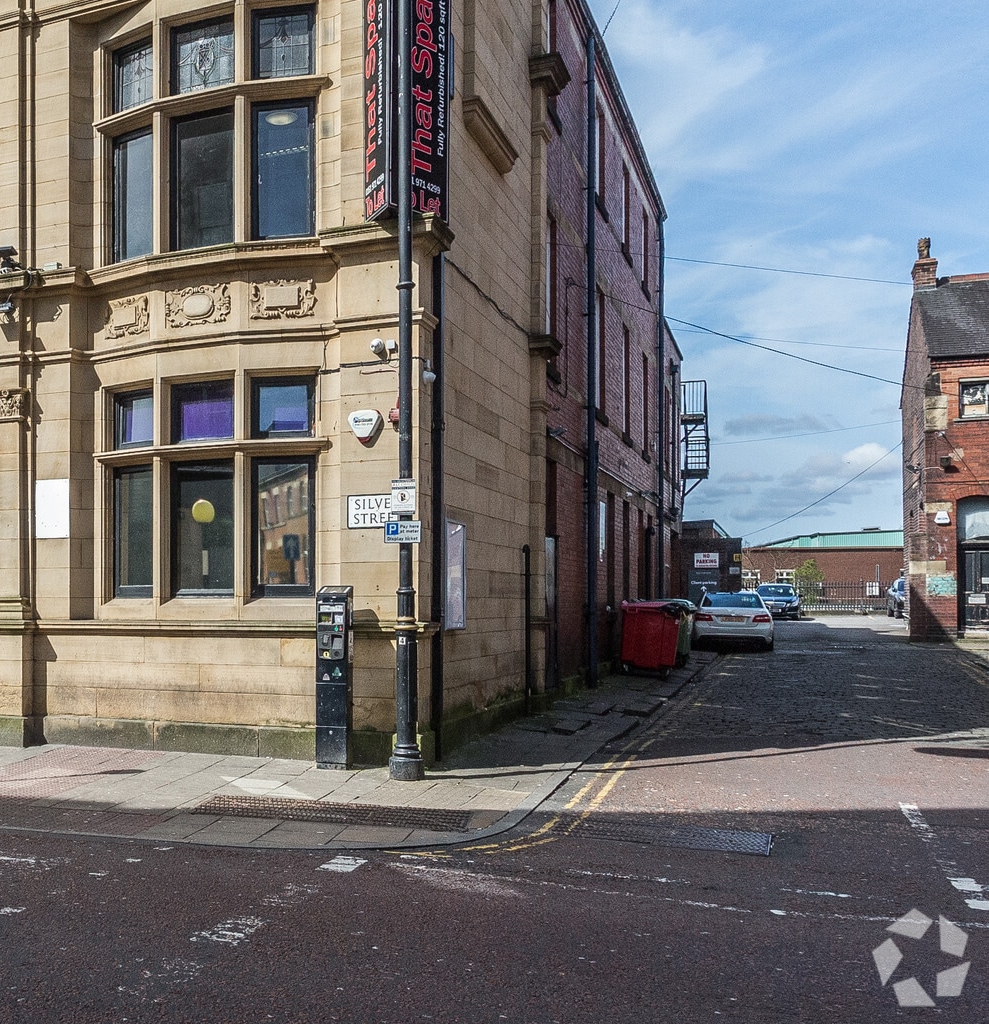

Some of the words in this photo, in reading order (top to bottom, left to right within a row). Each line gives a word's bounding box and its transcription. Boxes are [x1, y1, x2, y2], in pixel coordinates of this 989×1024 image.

[365, 83, 376, 183] That
[411, 85, 432, 175] That
[437, 130, 445, 157] Fully
[415, 178, 426, 189] 971
[427, 184, 441, 194] 4299
[366, 196, 373, 218] To
[374, 185, 385, 211] Let
[420, 190, 441, 217] Let
[354, 498, 391, 510] SILVE
[353, 513, 394, 525] STREE
[389, 525, 397, 534] P
